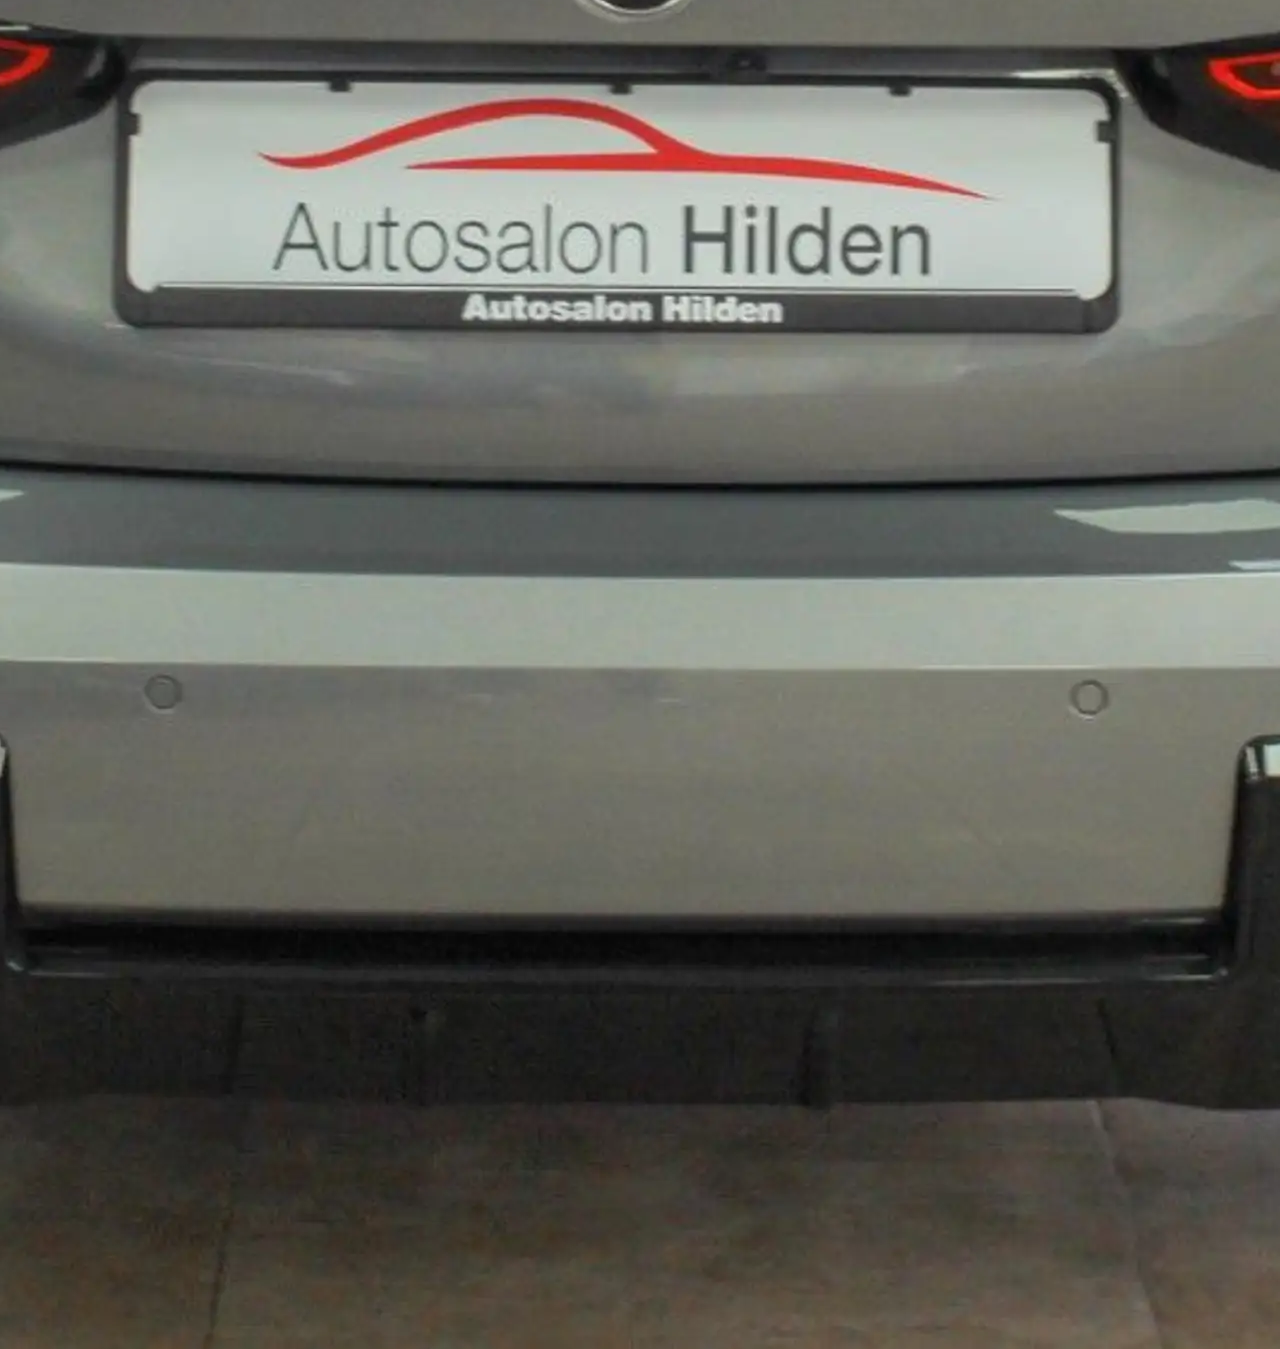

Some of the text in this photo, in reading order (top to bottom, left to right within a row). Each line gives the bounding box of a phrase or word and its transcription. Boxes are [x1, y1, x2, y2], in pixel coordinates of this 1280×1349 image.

[271, 202, 932, 276] Autosalon Hilden
[461, 293, 785, 324] Autosalon Hilden
